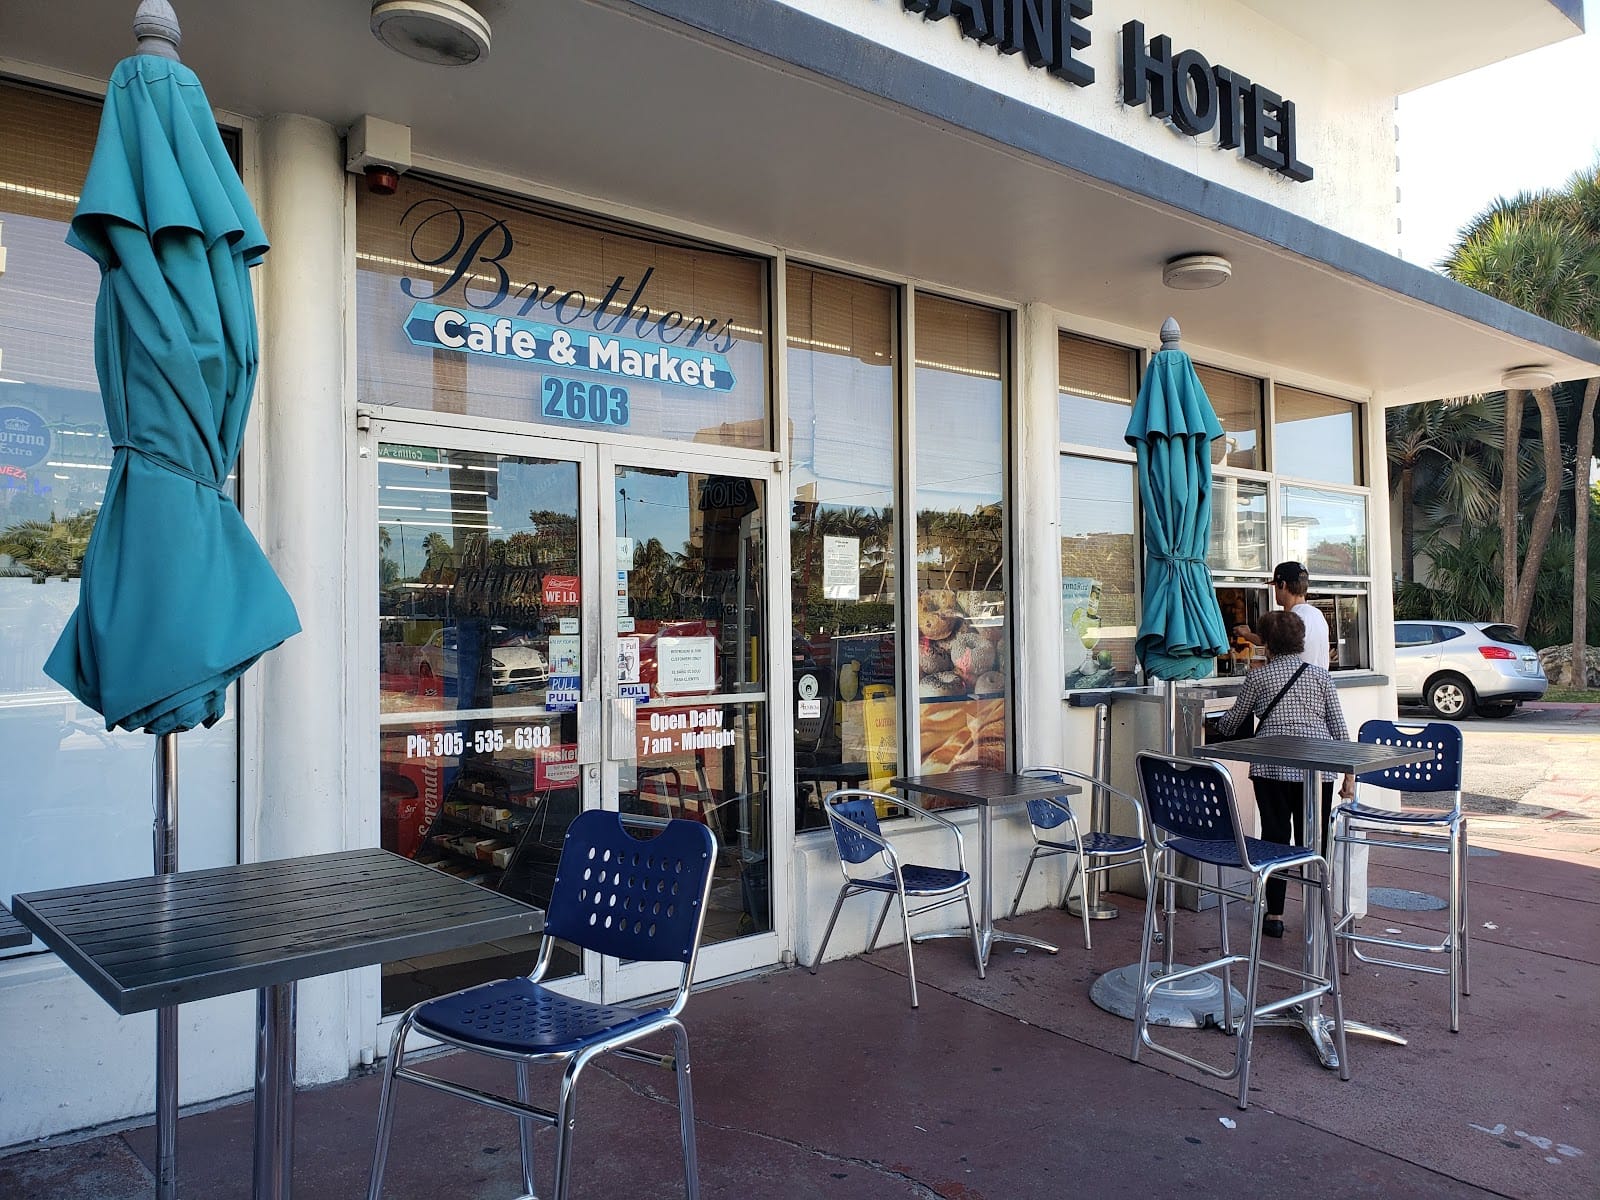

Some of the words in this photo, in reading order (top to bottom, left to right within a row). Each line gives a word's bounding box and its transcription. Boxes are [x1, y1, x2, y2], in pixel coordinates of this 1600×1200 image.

[1122, 18, 1314, 183] HOTEL
[399, 198, 738, 354] Brothers
[433, 309, 537, 359] Cafe
[548, 329, 577, 366] &
[588, 335, 716, 389] Market
[543, 377, 630, 426] 2603
[0, 431, 45, 447] orona
[545, 591, 561, 603] WE
[551, 677, 577, 691] PULL
[620, 686, 647, 696] PULL
[548, 693, 578, 702] PULL
[650, 712, 687, 733] Open
[689, 708, 724, 728] Daily
[406, 734, 431, 759] Ph:
[433, 731, 464, 756] 305
[474, 729, 504, 753] 535
[514, 725, 551, 751] 6388
[642, 736, 650, 755] 7
[651, 736, 672, 754] am
[681, 729, 736, 751] Midnight
